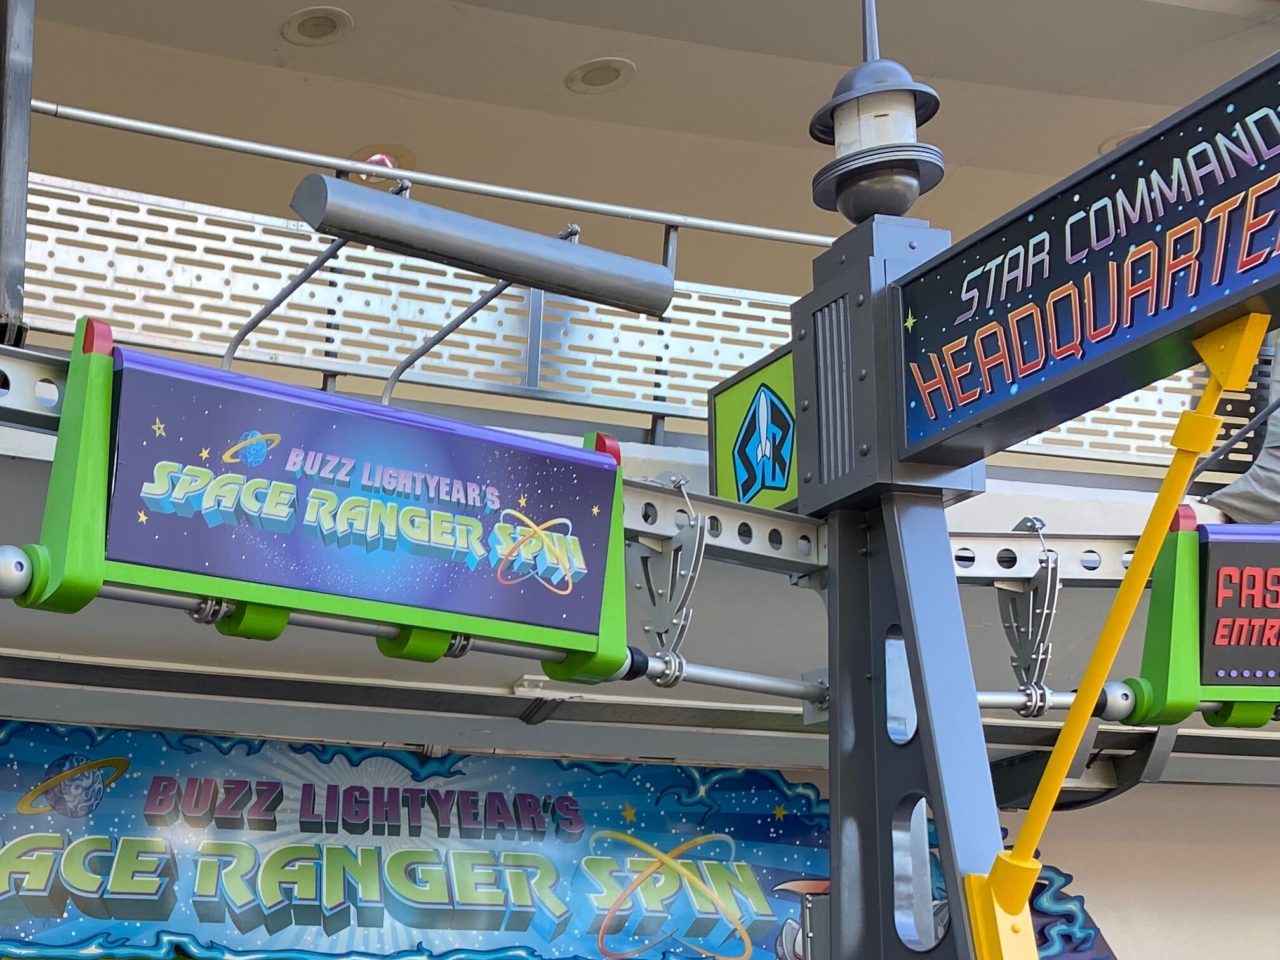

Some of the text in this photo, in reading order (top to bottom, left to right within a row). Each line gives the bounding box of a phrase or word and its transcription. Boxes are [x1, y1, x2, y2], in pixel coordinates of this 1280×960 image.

[953, 107, 1280, 325] STAR COMMAND
[909, 173, 1280, 420] HEADQUARTE
[140, 461, 588, 586] SPACE RANGER SPIN
[285, 448, 501, 514] BUZZ LIGHTYEAR'S
[144, 775, 585, 843] BUZZ LIGHTYEAR'S
[192, 840, 573, 941] RANGER
[578, 855, 779, 942] SPIN
